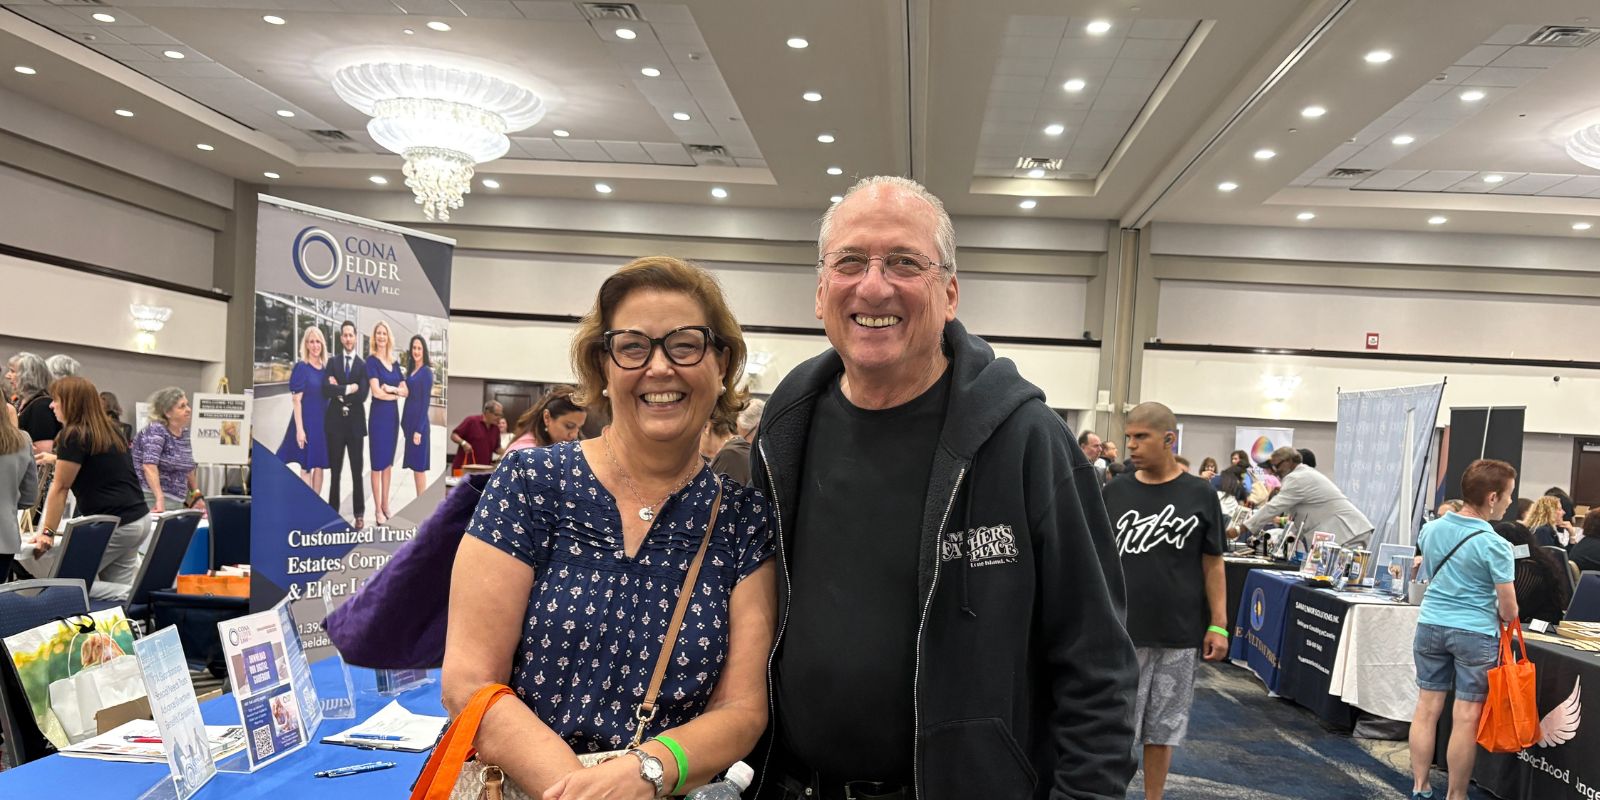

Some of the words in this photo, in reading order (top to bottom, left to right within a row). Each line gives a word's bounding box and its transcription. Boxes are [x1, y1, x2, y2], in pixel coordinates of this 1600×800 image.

[345, 236, 397, 262] CONA
[346, 255, 401, 281] ELDER
[346, 275, 381, 296] LAW
[382, 285, 400, 296] PLLC
[288, 527, 374, 548] Customized
[378, 525, 418, 542] Trust
[967, 541, 1019, 562] PLACE
[287, 555, 346, 575] Estates,
[287, 583, 302, 601] &
[306, 580, 347, 599] Elder
